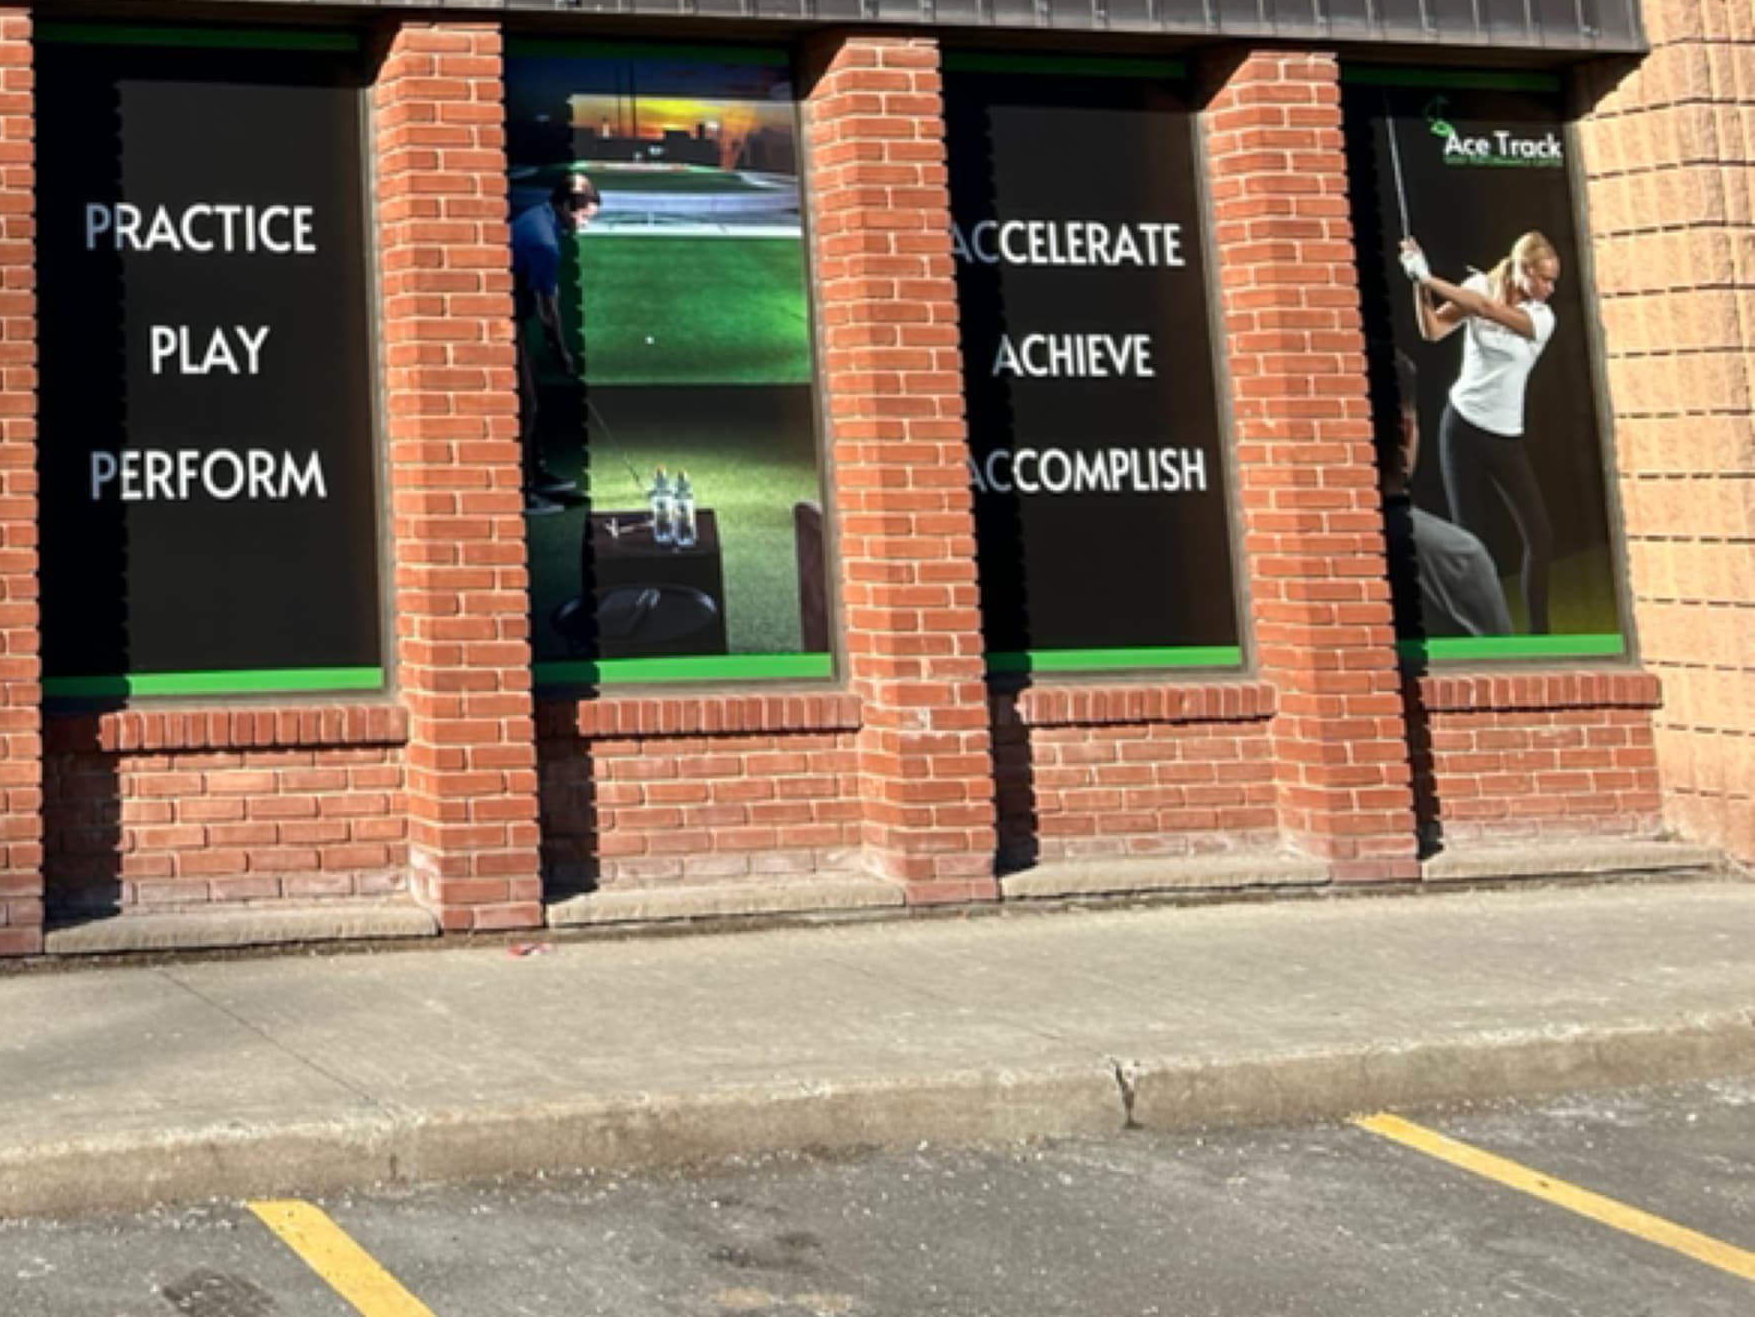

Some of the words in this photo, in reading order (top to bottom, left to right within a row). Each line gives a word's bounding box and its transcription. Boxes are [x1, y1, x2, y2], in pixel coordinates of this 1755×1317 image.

[1444, 130, 1489, 156] Ace
[1493, 130, 1562, 159] Track
[85, 201, 318, 255] PRACTICE
[149, 323, 271, 376] PLAY
[991, 331, 1157, 379] ACHIEVE
[90, 447, 328, 501] PERFORM
